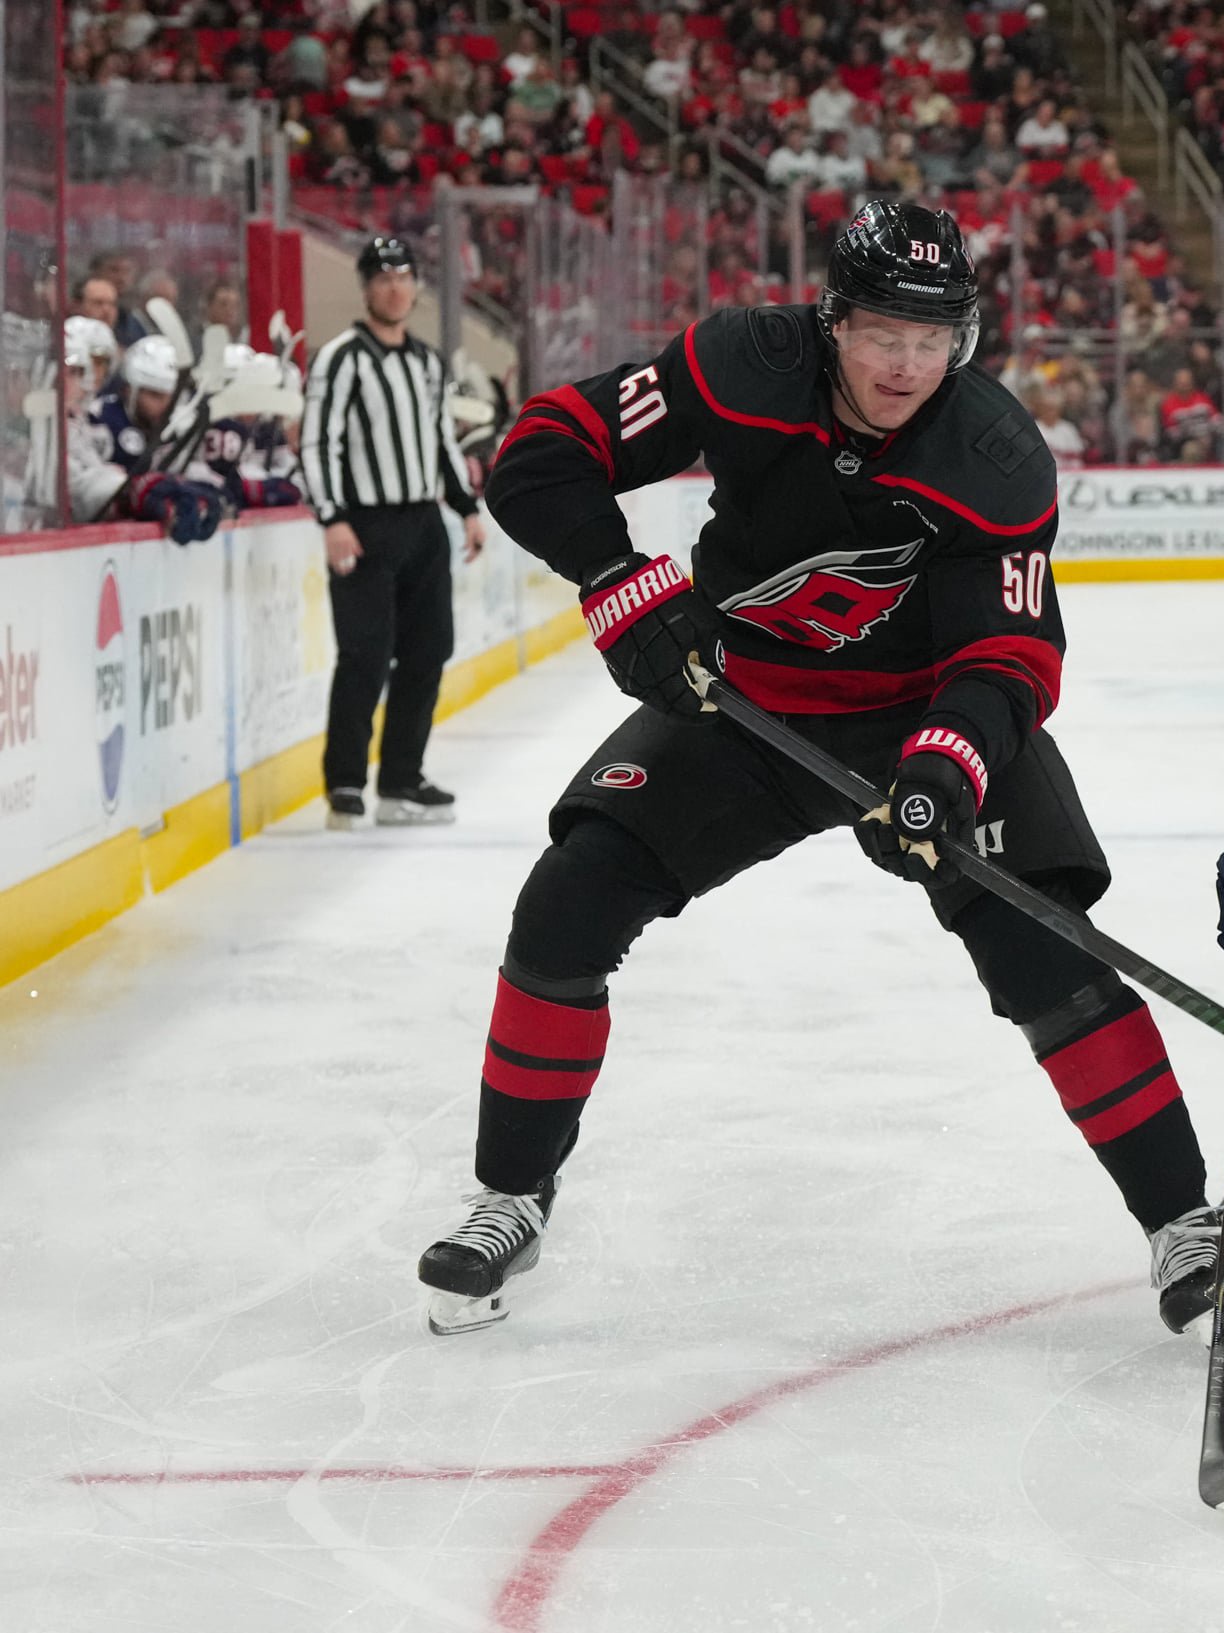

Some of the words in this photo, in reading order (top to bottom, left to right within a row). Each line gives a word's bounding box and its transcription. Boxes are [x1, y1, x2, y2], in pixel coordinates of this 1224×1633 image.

[910, 240, 940, 264] 50
[897, 281, 945, 294] WARRIOR
[618, 364, 669, 442] 50
[590, 561, 627, 588] ROBINSON
[1001, 551, 1046, 619] 50
[584, 559, 688, 641] WARRIO
